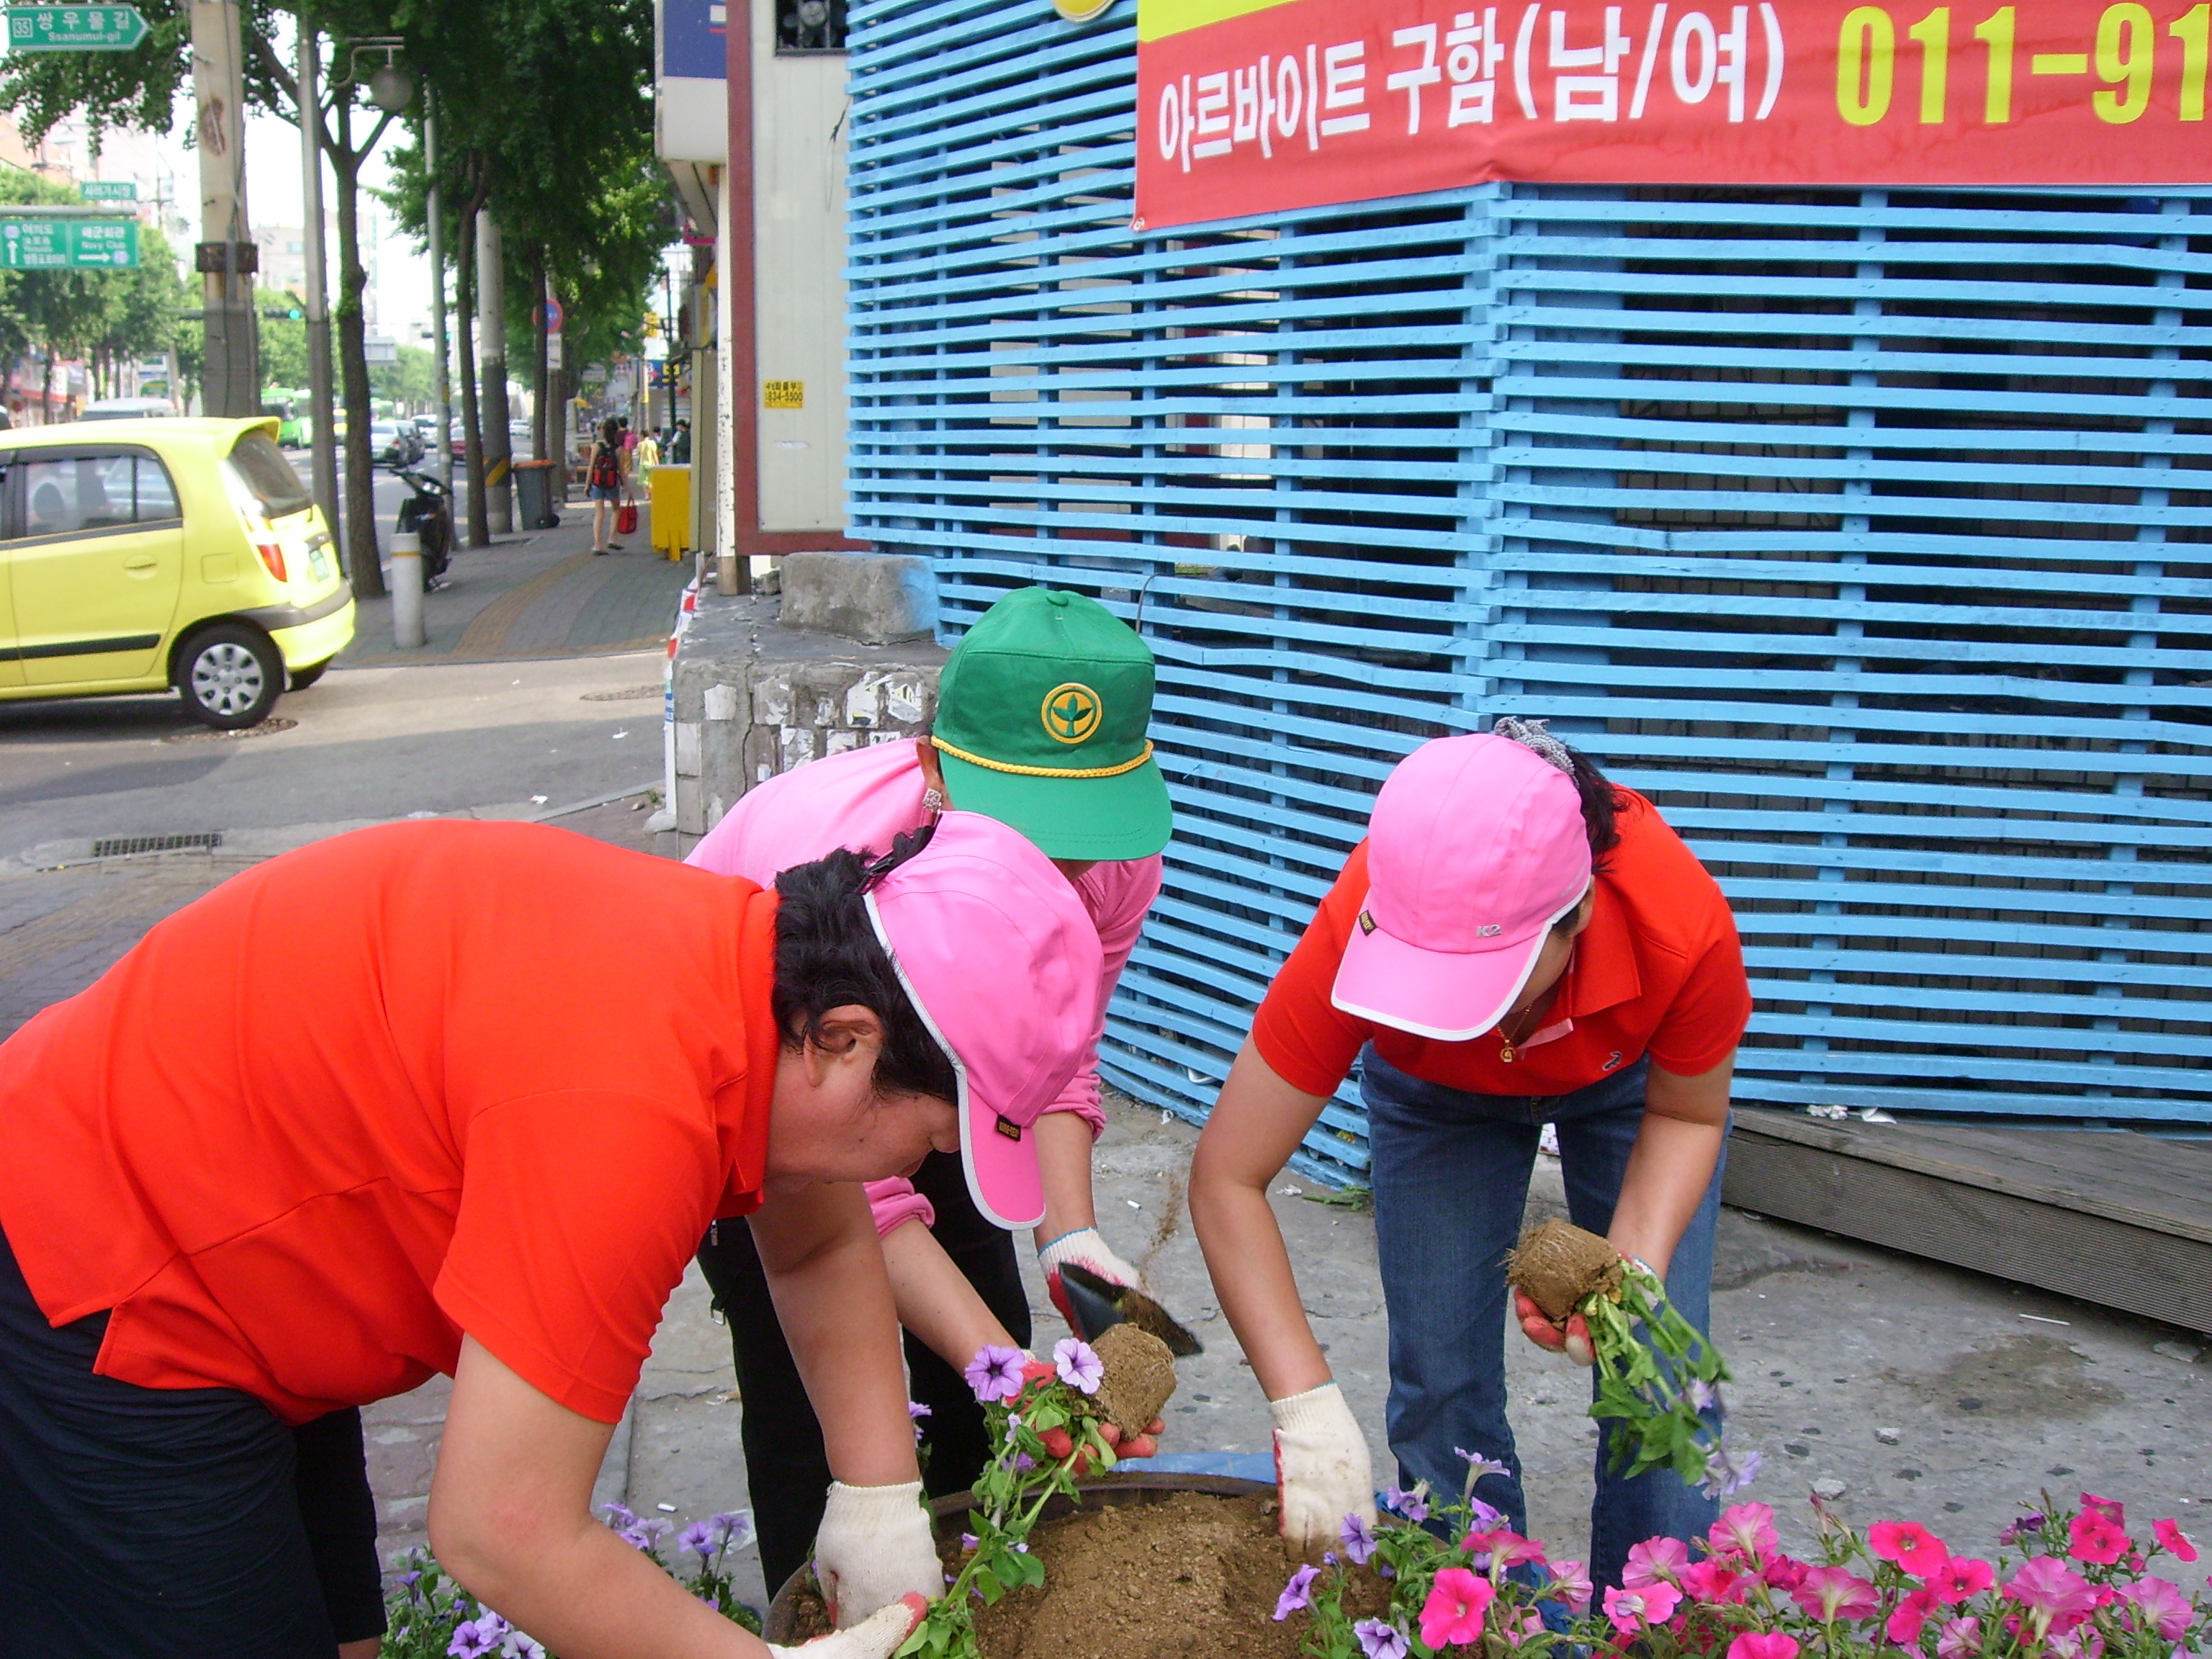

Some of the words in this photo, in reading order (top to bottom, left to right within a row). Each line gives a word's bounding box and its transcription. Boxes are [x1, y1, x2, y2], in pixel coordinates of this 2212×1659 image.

[16, 21, 29, 35] 35
[37, 11, 130, 30] 쌍우물길
[1158, 40, 1371, 173] 아르바이트
[1386, 10, 1506, 135] 구함
[1514, 1, 1784, 122] (남/여)
[1475, 923, 1502, 938] K2
